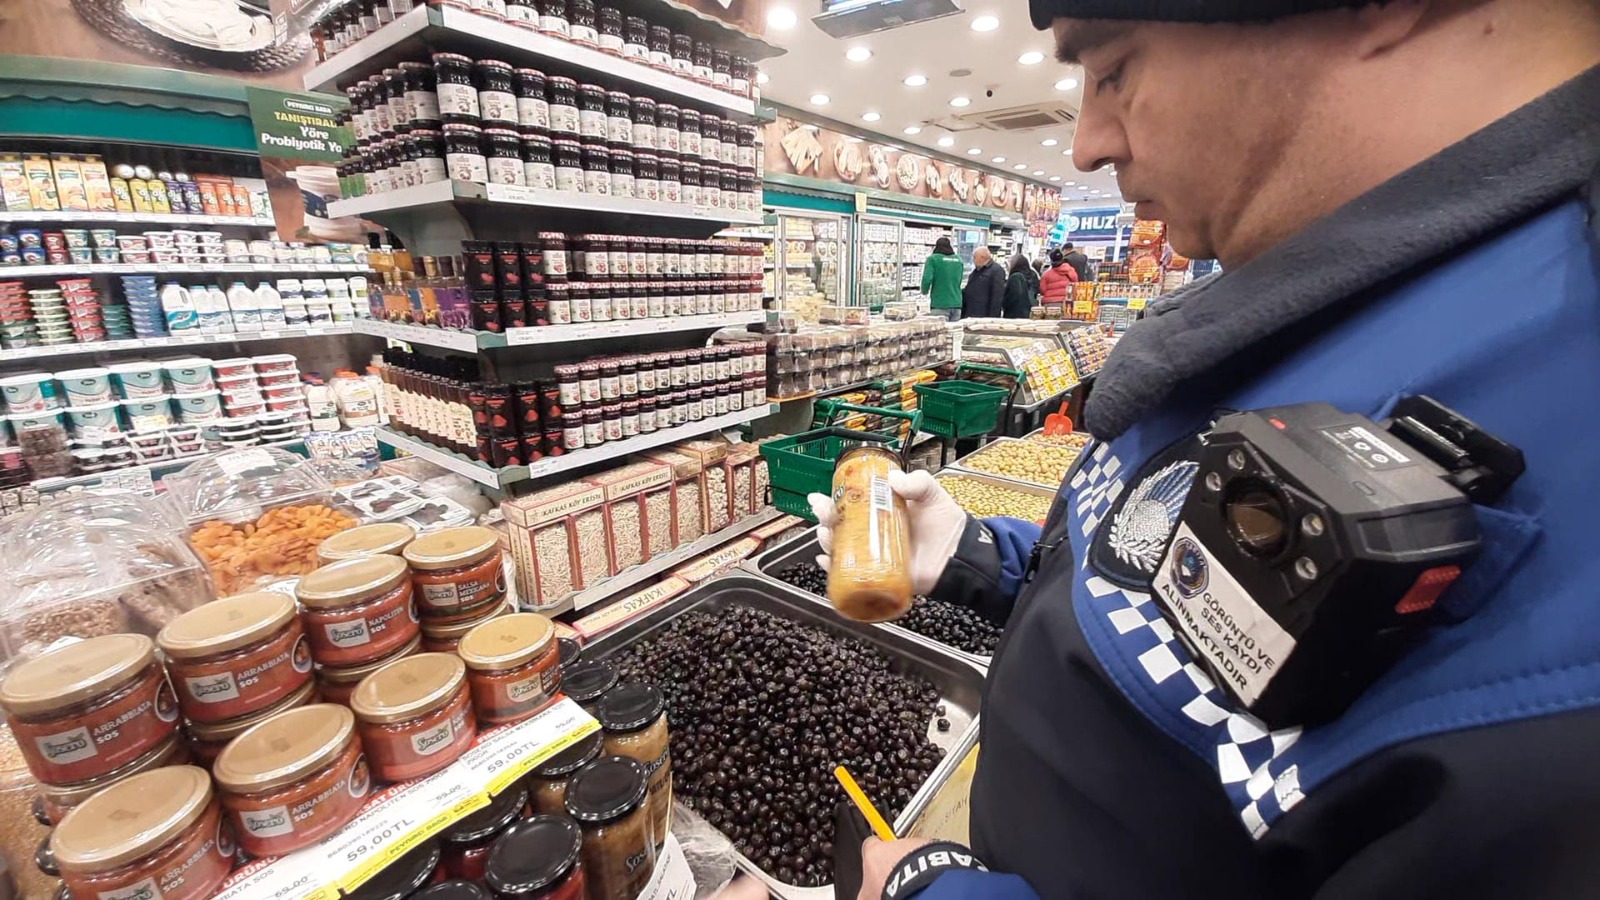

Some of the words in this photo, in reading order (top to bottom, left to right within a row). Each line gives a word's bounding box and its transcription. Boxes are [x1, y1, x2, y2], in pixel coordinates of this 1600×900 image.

[274, 111, 337, 128] TANIŞTIRAL
[261, 132, 325, 151] Probiyotik
[300, 126, 329, 139] Yöre
[622, 481, 641, 491] KAFKAS
[543, 503, 567, 516] KAFKAS
[625, 587, 663, 612] KAFKAS
[368, 606, 404, 626] NAPOLITEN
[370, 624, 387, 634] SOS
[1162, 583, 1248, 690] ALINMAKTADIR
[1203, 592, 1256, 650] GÖRÜNTÜ
[1257, 648, 1276, 670] VE
[1201, 607, 1223, 634] SES
[1223, 633, 1262, 674] KAYDI
[237, 652, 290, 680] ARRABBIATA
[239, 676, 260, 688] SOS
[93, 701, 152, 735] ARRABBIATA
[97, 730, 120, 744] SOS
[417, 729, 449, 751] Sosero
[487, 740, 540, 773] 59,00TL
[292, 780, 346, 814] ARRABBIATA
[294, 809, 315, 822] SOS
[346, 817, 415, 862] 59,00TL
[160, 838, 215, 885] ARRABBIATA
[163, 877, 185, 893] SOS
[253, 868, 275, 883] SOS
